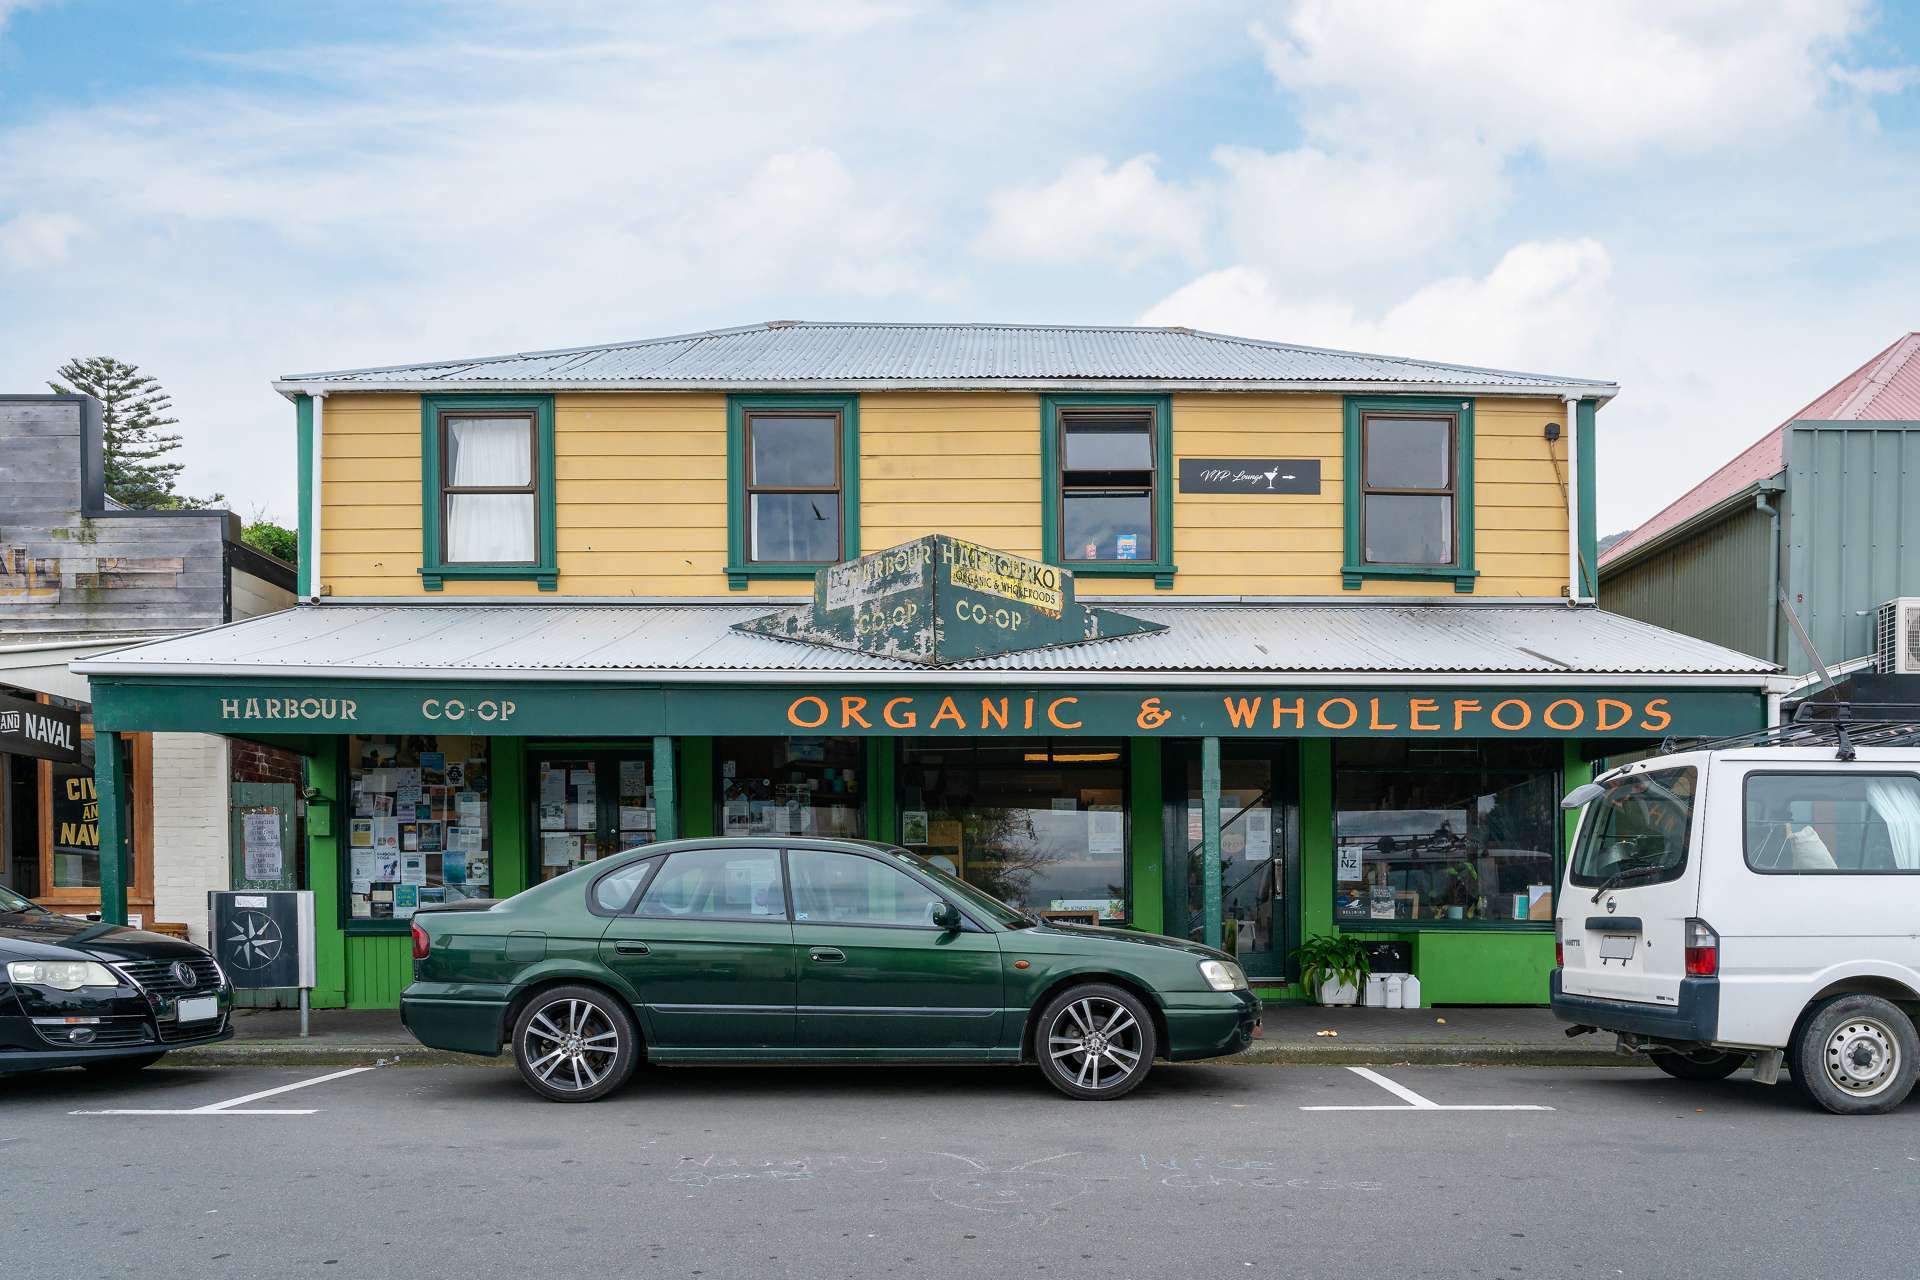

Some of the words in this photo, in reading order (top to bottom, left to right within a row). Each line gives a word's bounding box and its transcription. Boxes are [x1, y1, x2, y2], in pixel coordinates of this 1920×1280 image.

[1200, 469, 1231, 482] VIP
[1232, 470, 1263, 485] Lounge
[220, 697, 358, 721] HARBOUR
[421, 698, 517, 722] CO-OP
[787, 696, 1083, 730] ORGANIC
[1136, 697, 1173, 730] &
[1223, 697, 1673, 731] WHOLEFOODS
[0, 714, 20, 730] AND
[25, 712, 75, 751] NAVAL
[66, 777, 97, 801] CIV
[83, 804, 99, 820] AN
[60, 822, 100, 846] NAV
[1341, 860, 1357, 869] NZ
